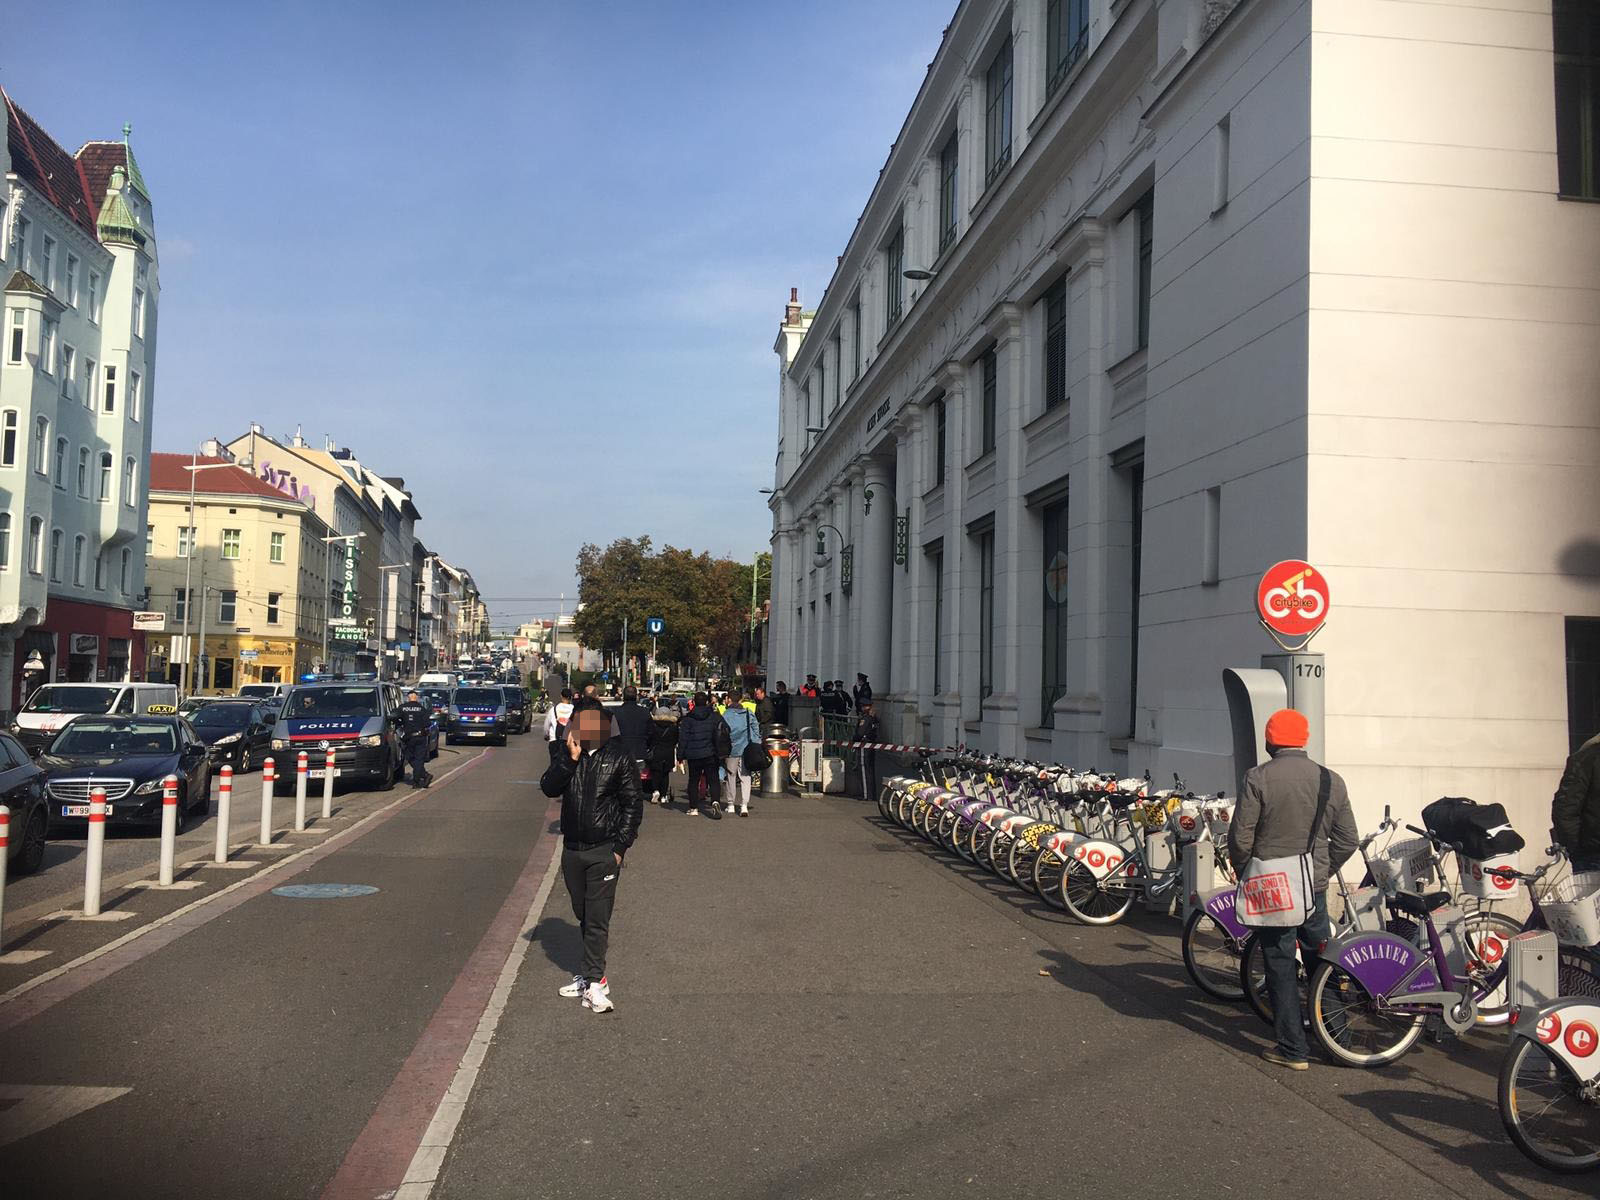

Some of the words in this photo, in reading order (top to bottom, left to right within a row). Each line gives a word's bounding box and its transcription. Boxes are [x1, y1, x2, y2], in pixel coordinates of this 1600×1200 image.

[1275, 597, 1313, 608] citybike
[651, 621, 662, 632] U
[1295, 663, 1325, 678] 170
[152, 705, 173, 713] TAXI
[1261, 876, 1279, 889] SIND
[1247, 887, 1283, 912] WIEN
[1344, 943, 1409, 968] VÖSLAUER
